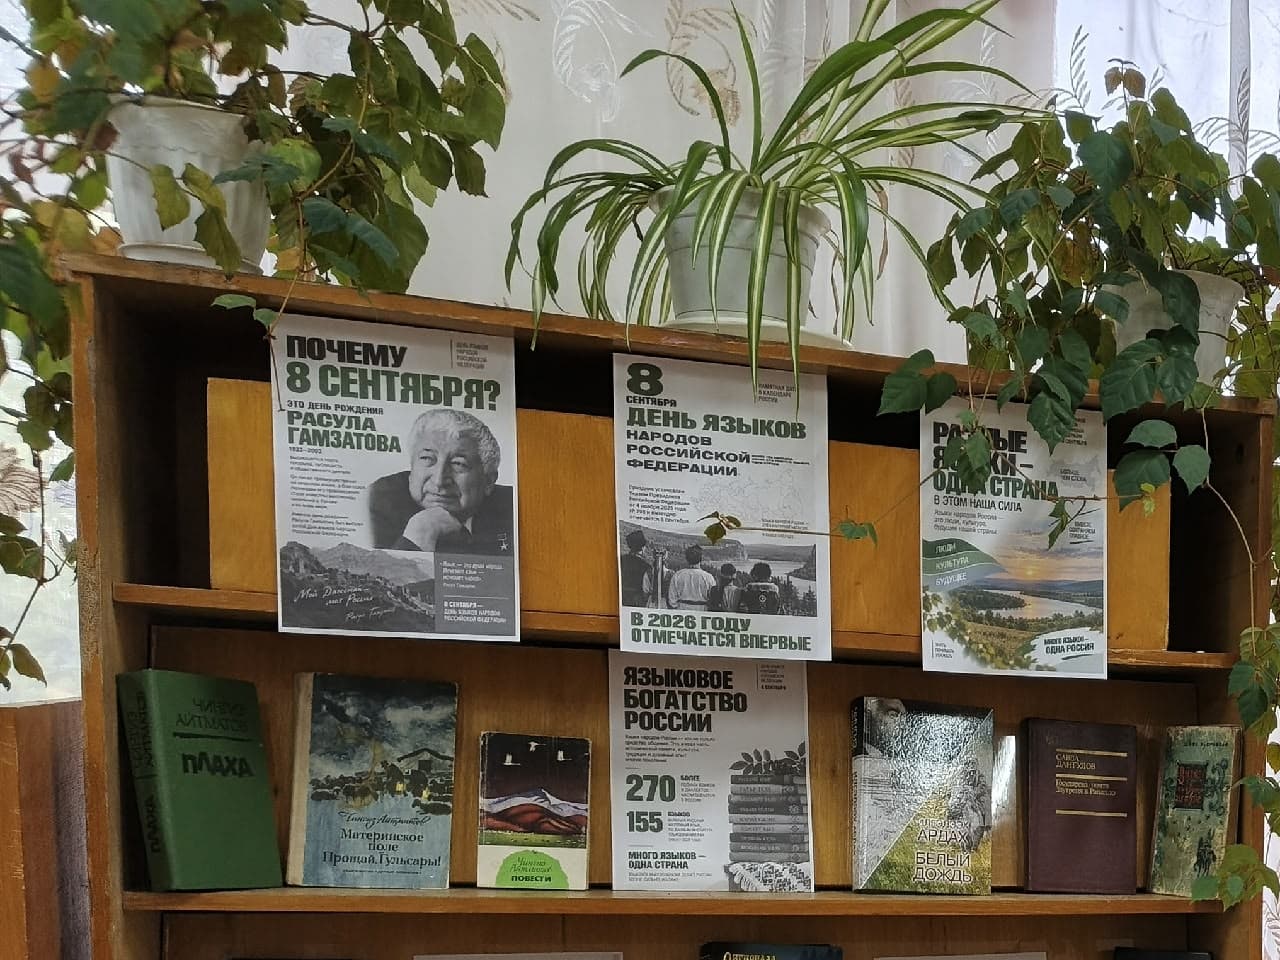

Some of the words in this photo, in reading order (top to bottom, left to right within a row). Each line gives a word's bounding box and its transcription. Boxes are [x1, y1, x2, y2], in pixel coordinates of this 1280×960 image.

[287, 335, 408, 368] ПОЧЕМУ
[286, 361, 311, 394] 8
[319, 364, 501, 411] СЕНТЯБРЯ?
[626, 362, 664, 396] 8
[626, 395, 678, 407] СЕНТЯБРЯ
[287, 410, 377, 432] РАСУЛА
[626, 407, 697, 430] ДЕНЬ
[702, 414, 807, 439] ЯЗЫКОВ
[288, 426, 402, 453] ГАМЗАТОВА
[626, 430, 712, 446] НАРОДОВ
[626, 444, 751, 464] РОССИЙСКОЙ
[626, 459, 738, 477] ФЕДЕРАЦИИ
[934, 495, 940, 505] В
[942, 496, 967, 507] ЭТОМ
[970, 498, 996, 510] НАША
[998, 501, 1022, 512] СИЛА
[631, 612, 643, 626] В
[649, 614, 697, 630] 2026
[701, 616, 751, 633] ГОДУ
[631, 628, 736, 648] ОТМЕЧАЕТСЯ
[739, 634, 812, 651] ВПЕРВЫЕ
[624, 667, 733, 690] ЯЗЫКОВОЕ
[624, 689, 748, 713] БОГАТСТВО
[624, 711, 713, 733] РОССИИ
[182, 752, 255, 778] ПЛАХА
[625, 775, 676, 803] 270
[626, 811, 664, 833] 155
[340, 828, 424, 843] Материнское
[917, 829, 968, 845] АРДАХ
[628, 851, 659, 861] МНОГО
[661, 852, 697, 862] ЯЗЫКОВ
[628, 860, 652, 871] ОДНА
[654, 861, 689, 871] СТРАНА
[916, 850, 971, 868] БЕЛЫЙ
[511, 875, 552, 883] ПОВЕСТИ
[912, 867, 973, 884] ДОЖДЬ
